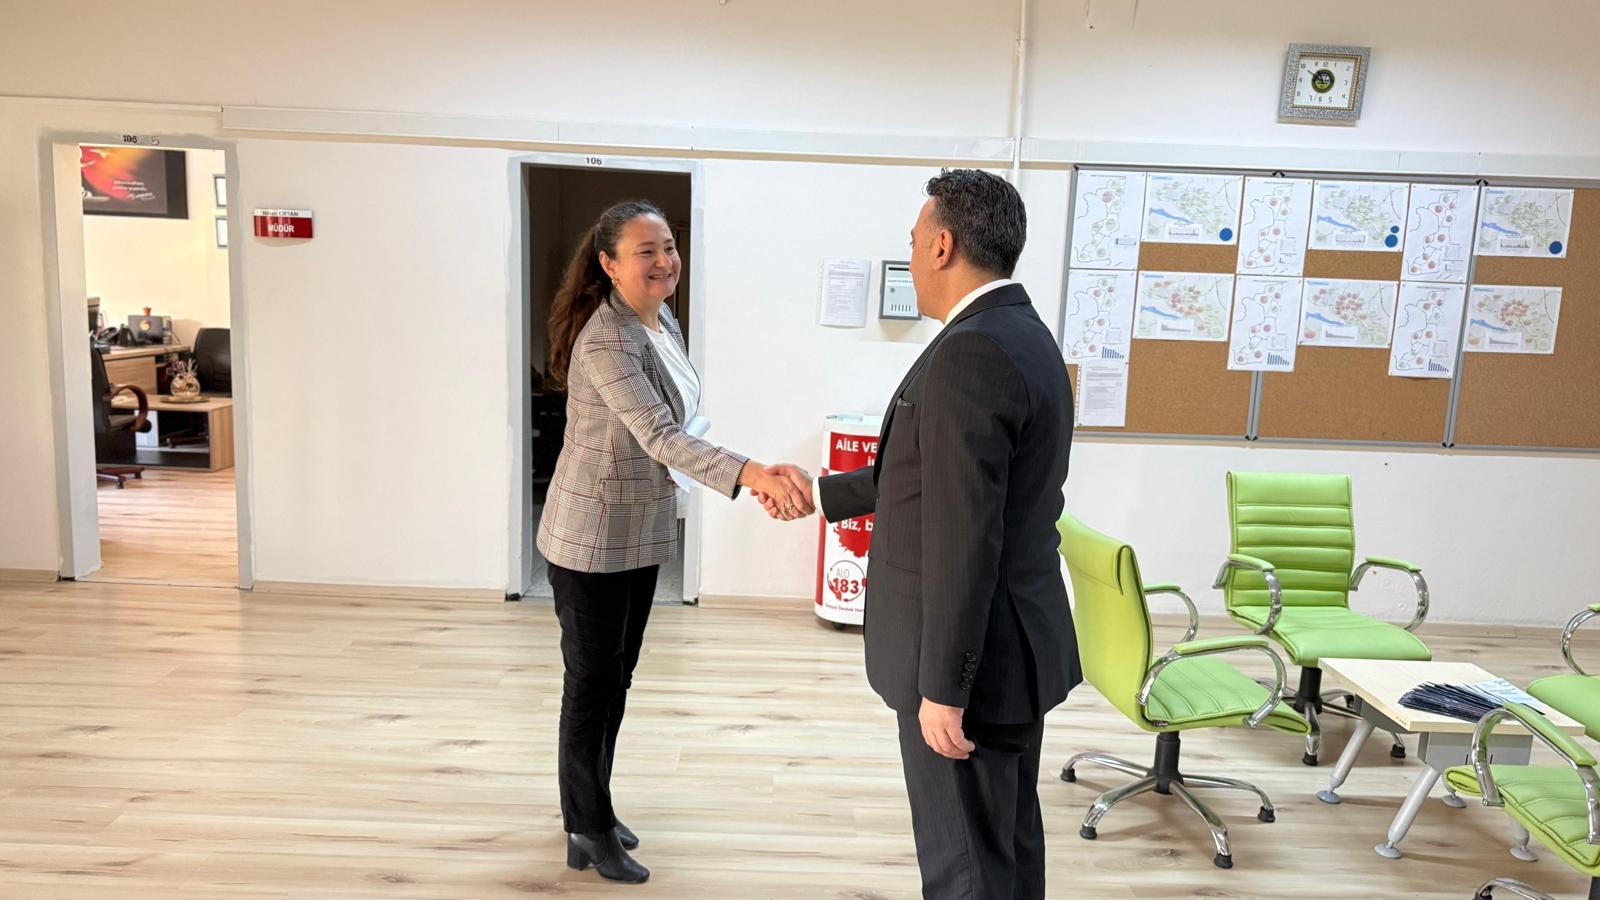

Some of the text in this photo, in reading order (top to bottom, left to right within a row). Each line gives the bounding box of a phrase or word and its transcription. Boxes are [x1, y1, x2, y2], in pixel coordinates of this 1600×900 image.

[585, 157, 602, 165] 106
[267, 223, 295, 233] MÜDÜR
[835, 437, 878, 453] AİLE VE
[841, 518, 861, 532] Biz,
[836, 568, 850, 578] ALO
[832, 578, 859, 594] 183
